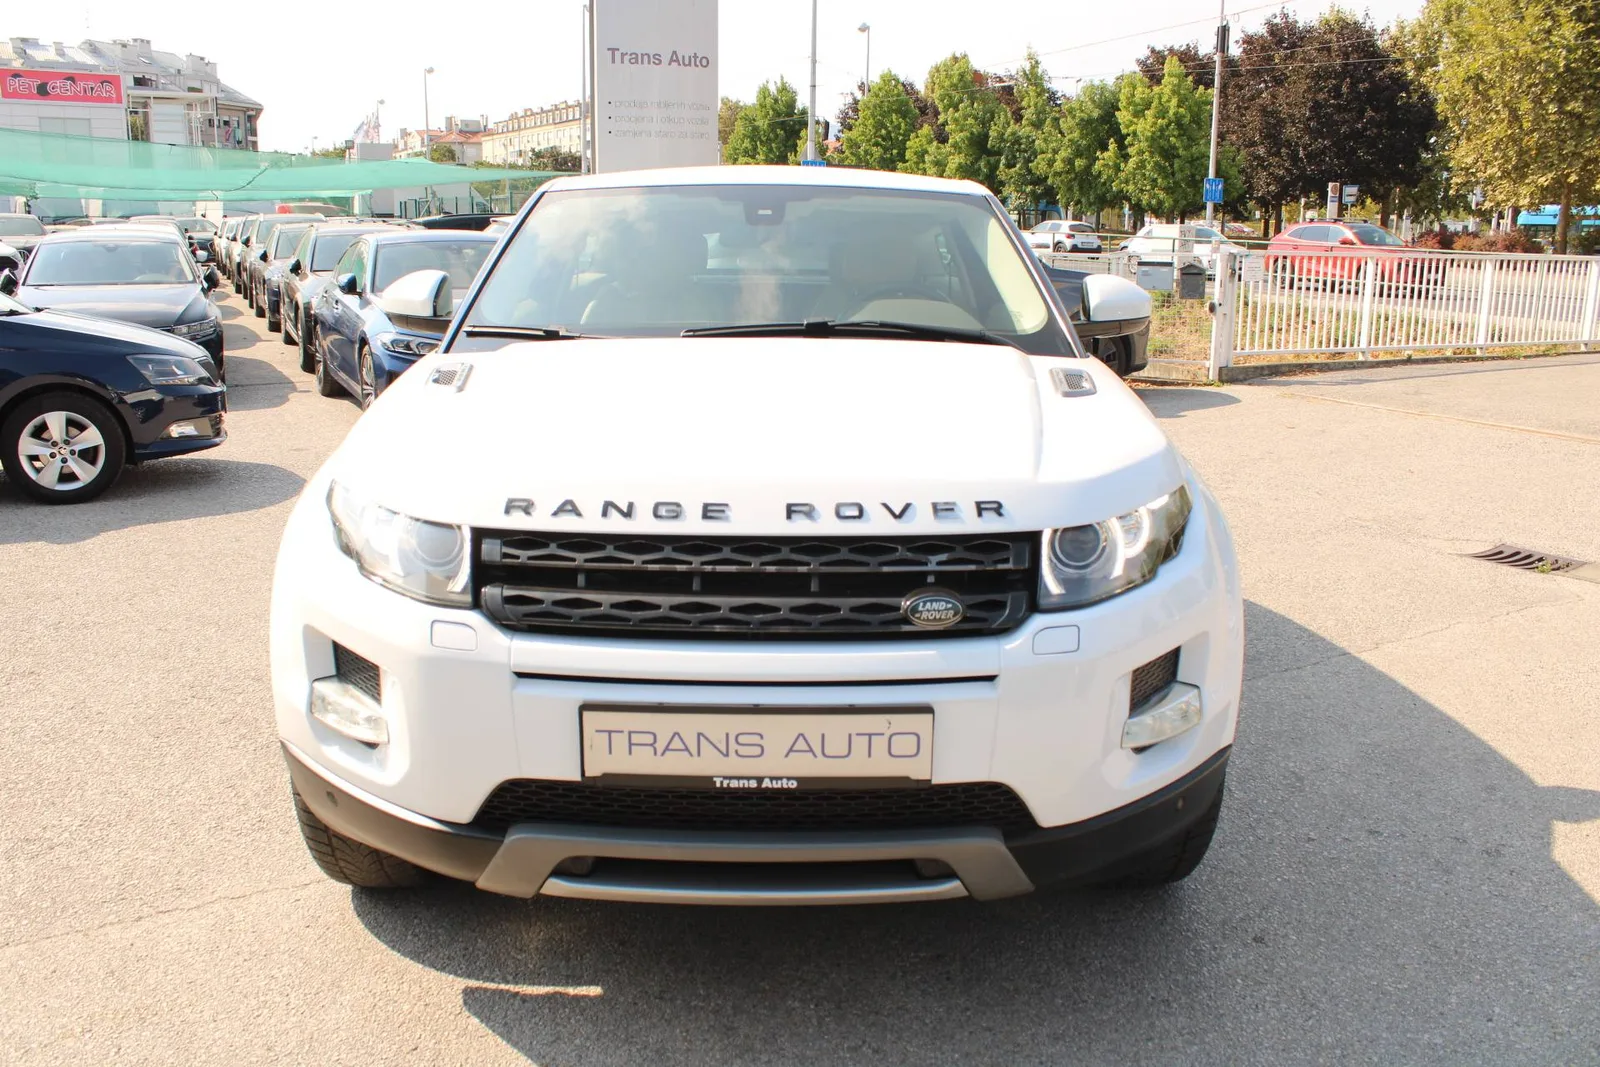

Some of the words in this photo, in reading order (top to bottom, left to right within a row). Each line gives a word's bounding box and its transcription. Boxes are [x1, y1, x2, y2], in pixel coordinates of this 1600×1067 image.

[607, 48, 662, 66] Trans
[668, 50, 710, 68] Auto
[7, 77, 40, 94] PET
[47, 79, 116, 98] CENTAR
[504, 498, 731, 521] RANGE
[786, 500, 1005, 521] ROVER
[918, 601, 946, 611] LAND
[920, 610, 954, 620] ROVER
[595, 729, 765, 758] TRANS
[784, 731, 920, 759] AUTO
[713, 777, 758, 788] Trans
[761, 778, 798, 789] Auto
